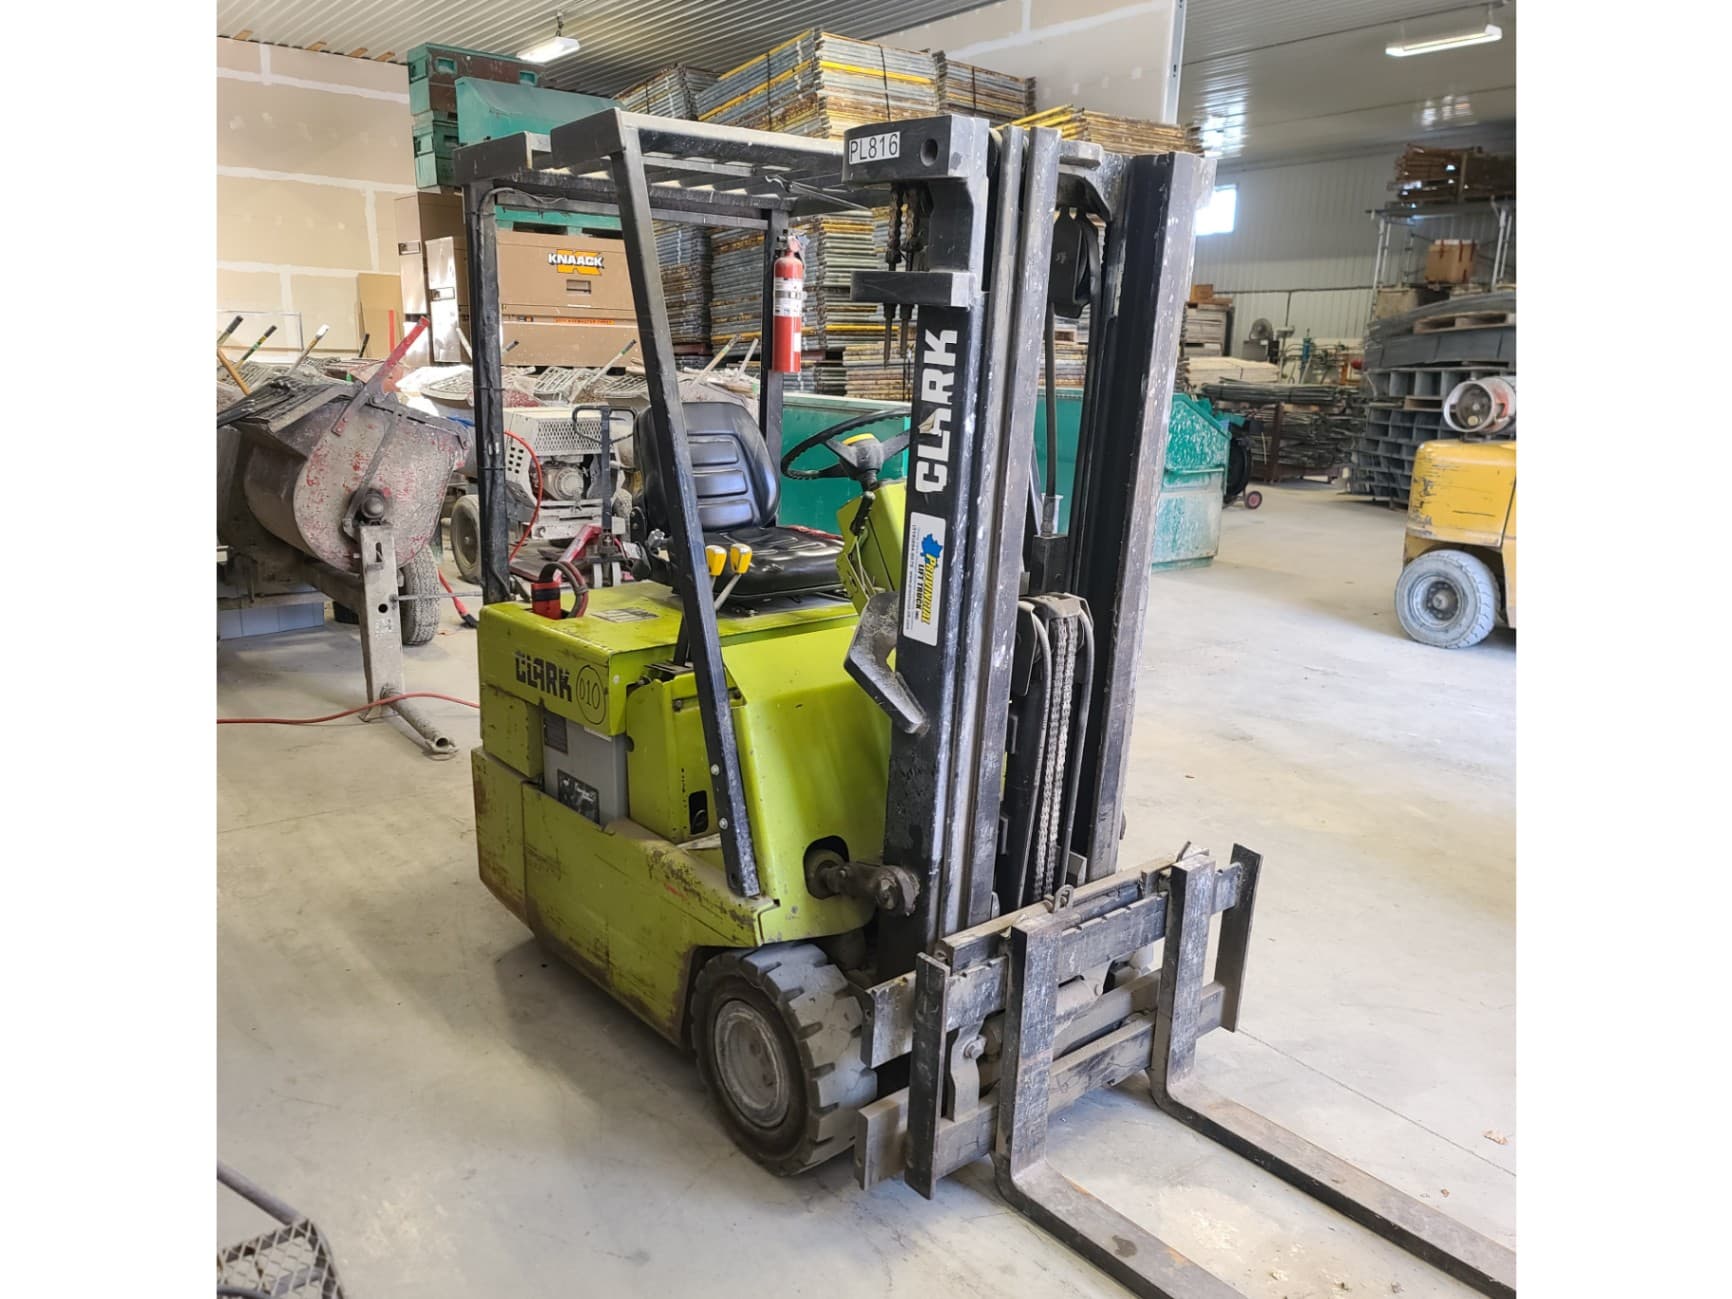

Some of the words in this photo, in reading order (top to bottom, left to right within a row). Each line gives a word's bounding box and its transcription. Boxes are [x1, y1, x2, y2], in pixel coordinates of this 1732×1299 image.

[850, 133, 898, 162] PL816
[548, 253, 604, 268] KNAACK
[915, 328, 958, 492] CLARK
[921, 553, 937, 625] PROVINCIAL
[514, 651, 572, 702] CLARK
